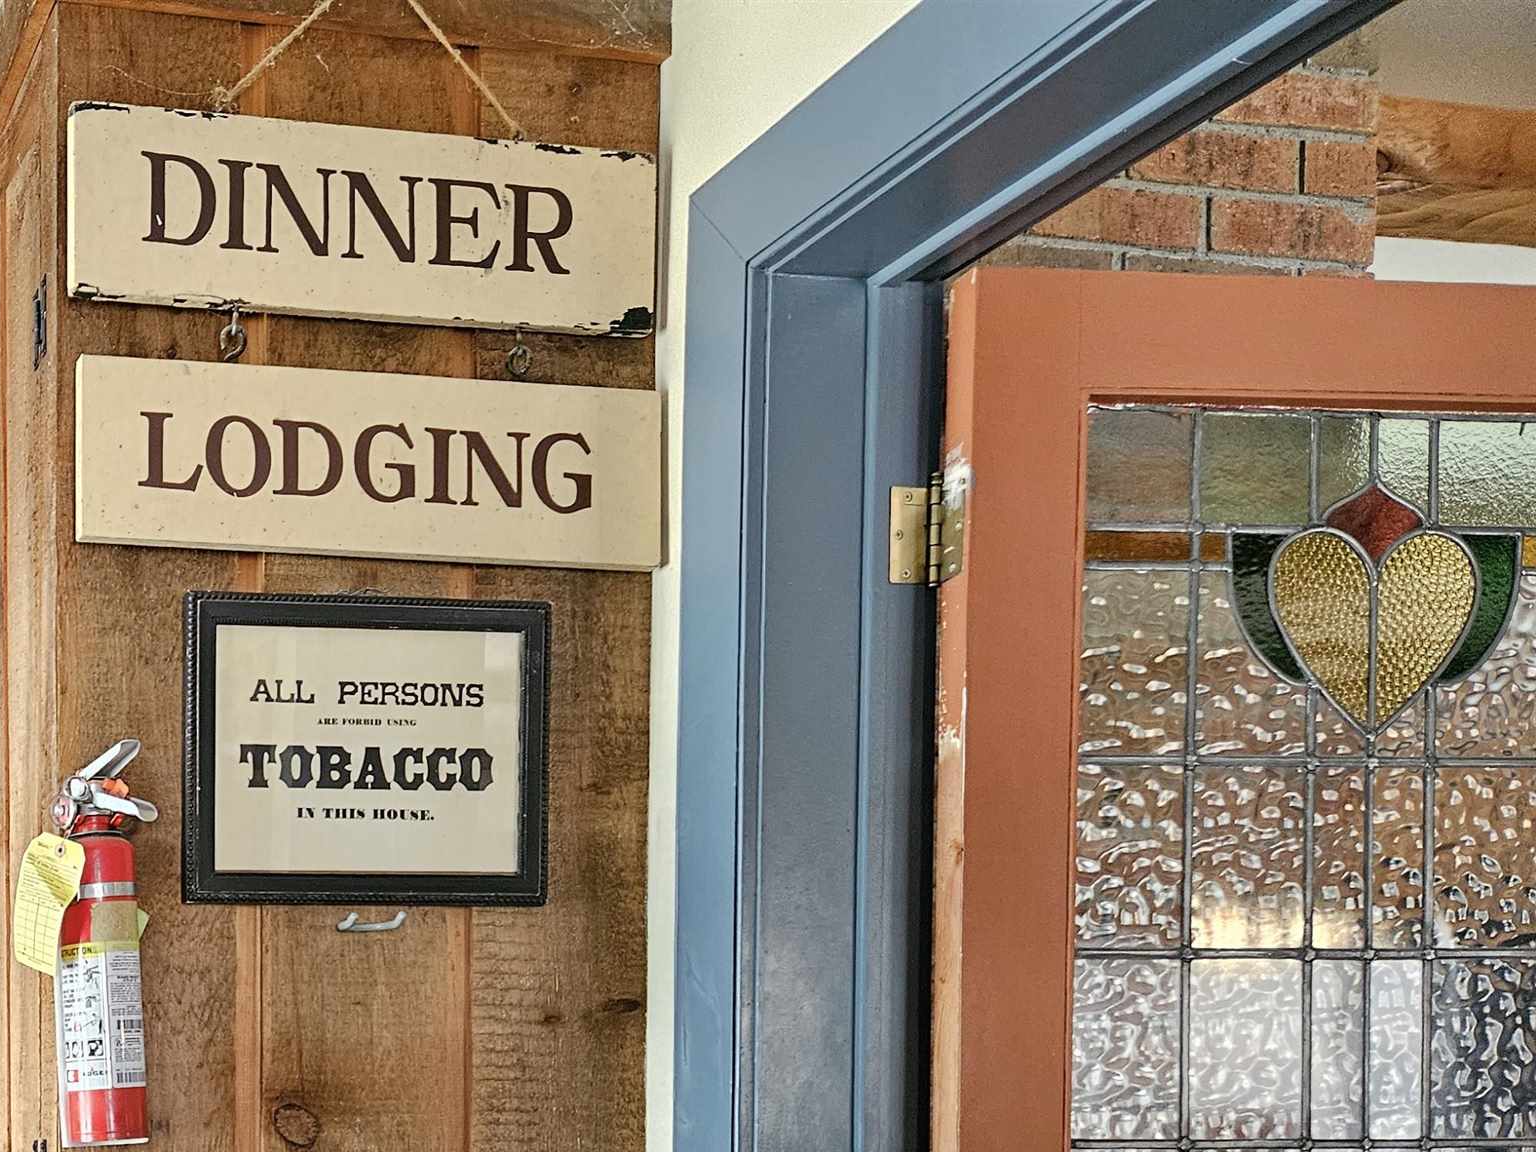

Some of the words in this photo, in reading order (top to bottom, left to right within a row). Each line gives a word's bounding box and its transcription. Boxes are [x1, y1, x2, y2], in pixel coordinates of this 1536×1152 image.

[140, 150, 573, 275] DINNER
[138, 411, 593, 514] LODGING
[250, 679, 314, 704] ALL
[338, 680, 484, 707] PERSONS
[317, 717, 338, 726] ARE
[342, 717, 382, 727] FORBID
[387, 718, 417, 727] USING
[239, 744, 494, 791] TOBACCO
[297, 807, 315, 819] IN
[322, 807, 365, 820] THIS
[372, 808, 434, 821] HOUSE.
